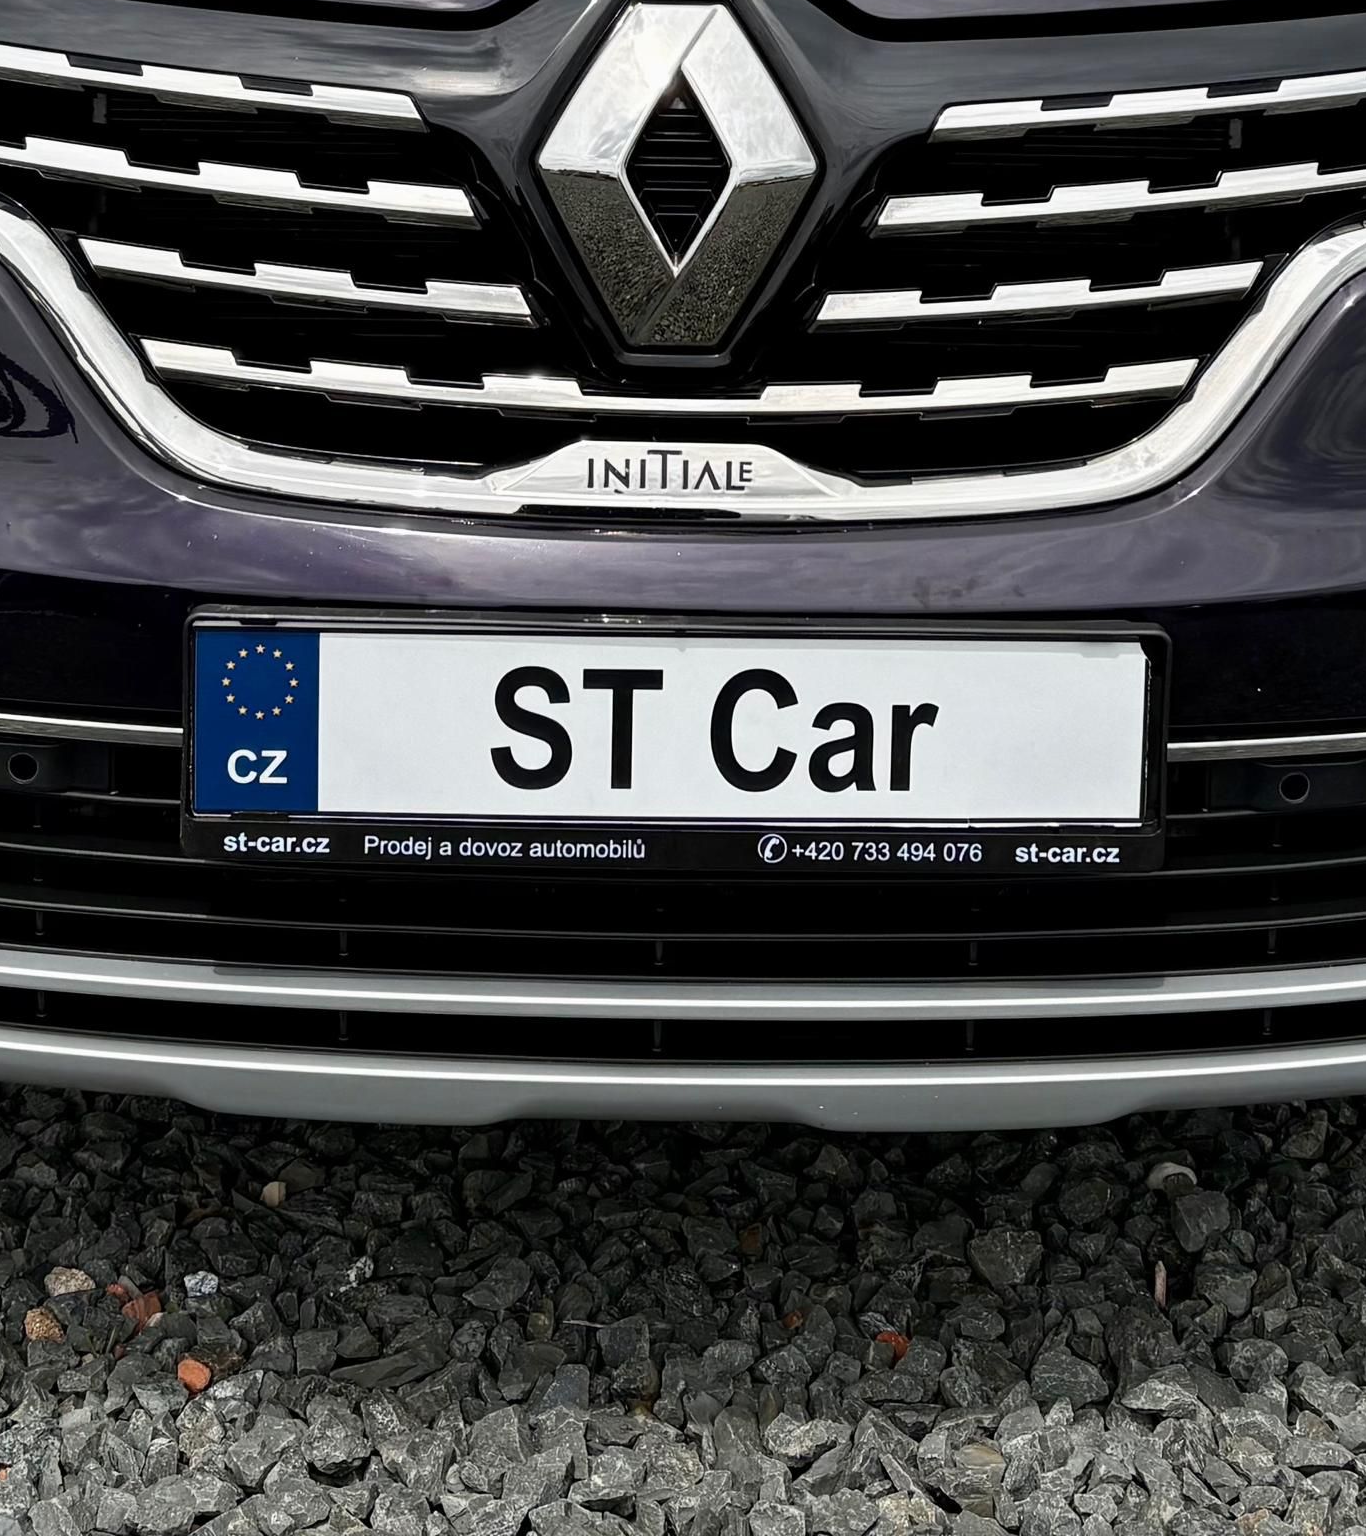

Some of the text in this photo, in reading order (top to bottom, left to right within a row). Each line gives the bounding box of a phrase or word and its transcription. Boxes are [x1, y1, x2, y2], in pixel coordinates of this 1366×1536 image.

[587, 449, 753, 491] INITIALE
[490, 665, 940, 793] ST Car
[227, 749, 288, 784] CZ
[223, 832, 330, 854] st-car.cz
[364, 835, 646, 860] Prodej a dovoz automobilů
[791, 841, 983, 863] +420 733 494 076
[1015, 842, 1120, 863] st-car.cz
